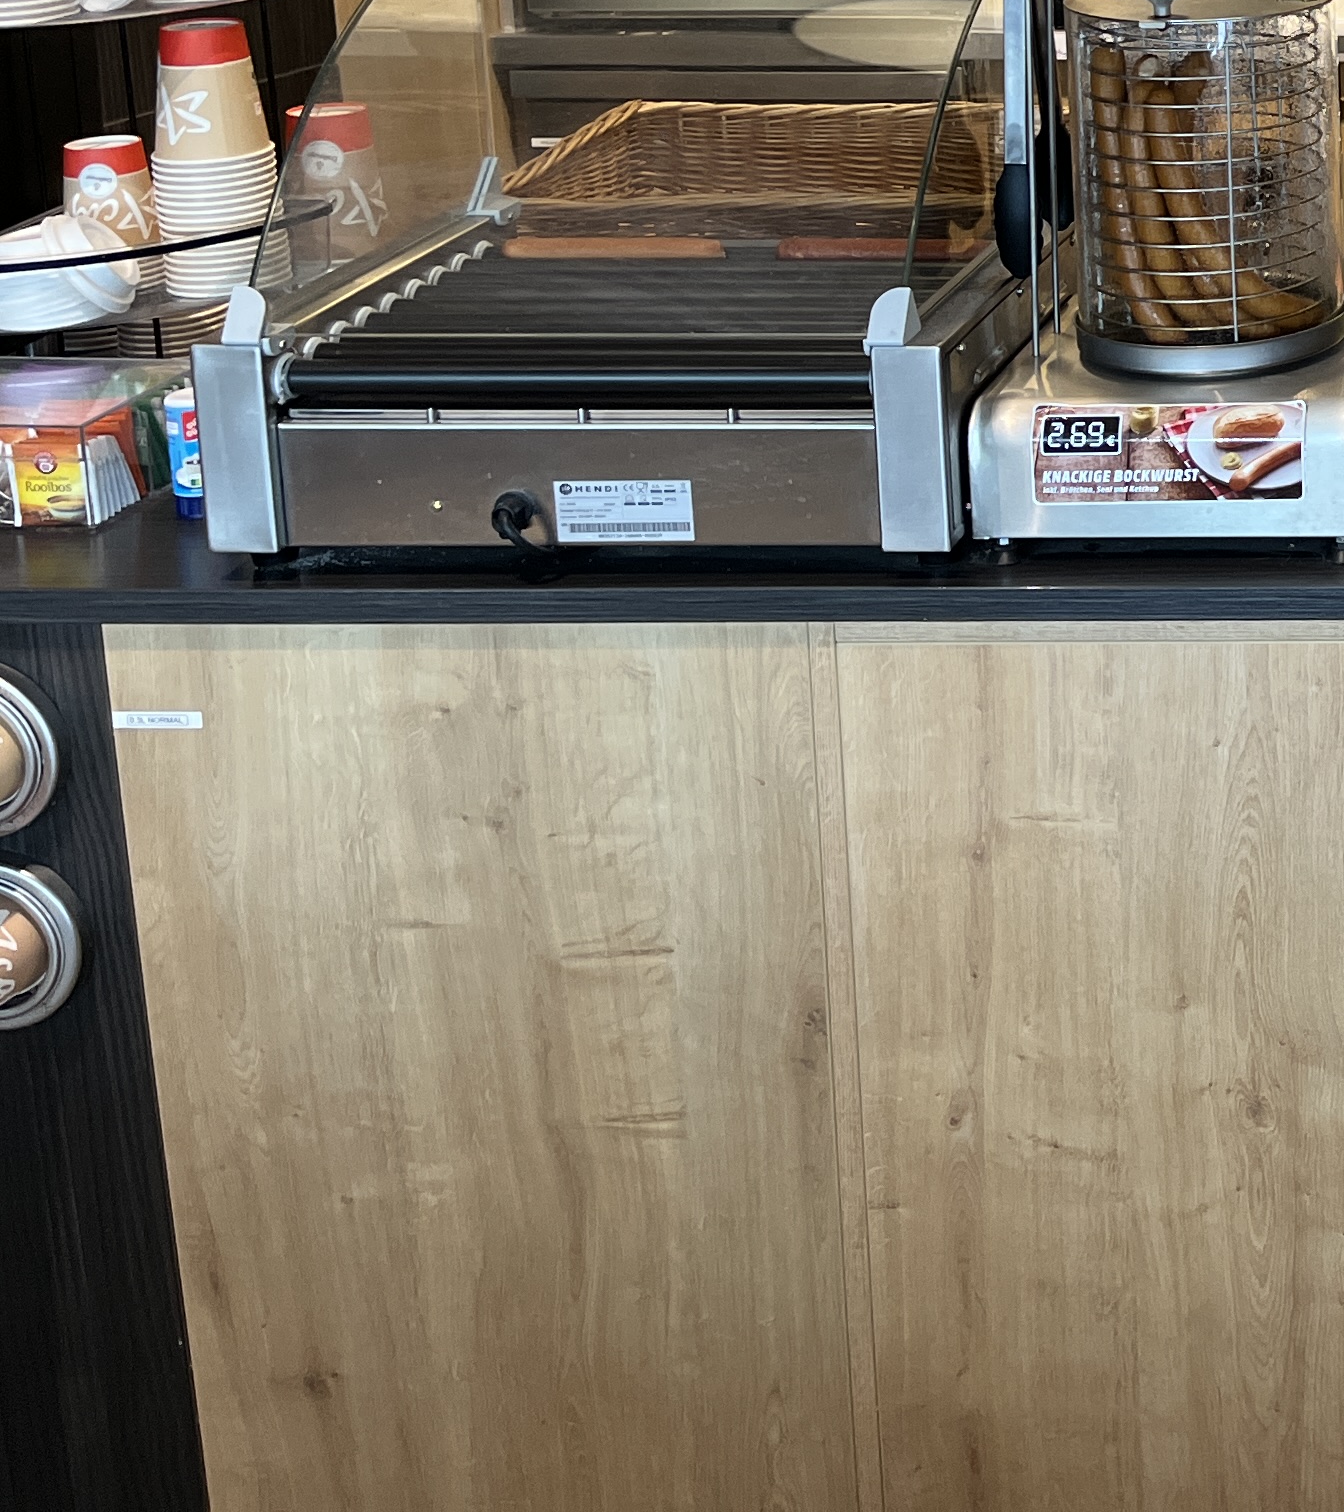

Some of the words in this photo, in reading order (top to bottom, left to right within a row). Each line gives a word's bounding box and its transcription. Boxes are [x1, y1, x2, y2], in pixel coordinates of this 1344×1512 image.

[1042, 470, 1111, 483] KNACKIGE
[1114, 469, 1199, 482] BOCKWURST
[25, 481, 72, 492] Rooibos
